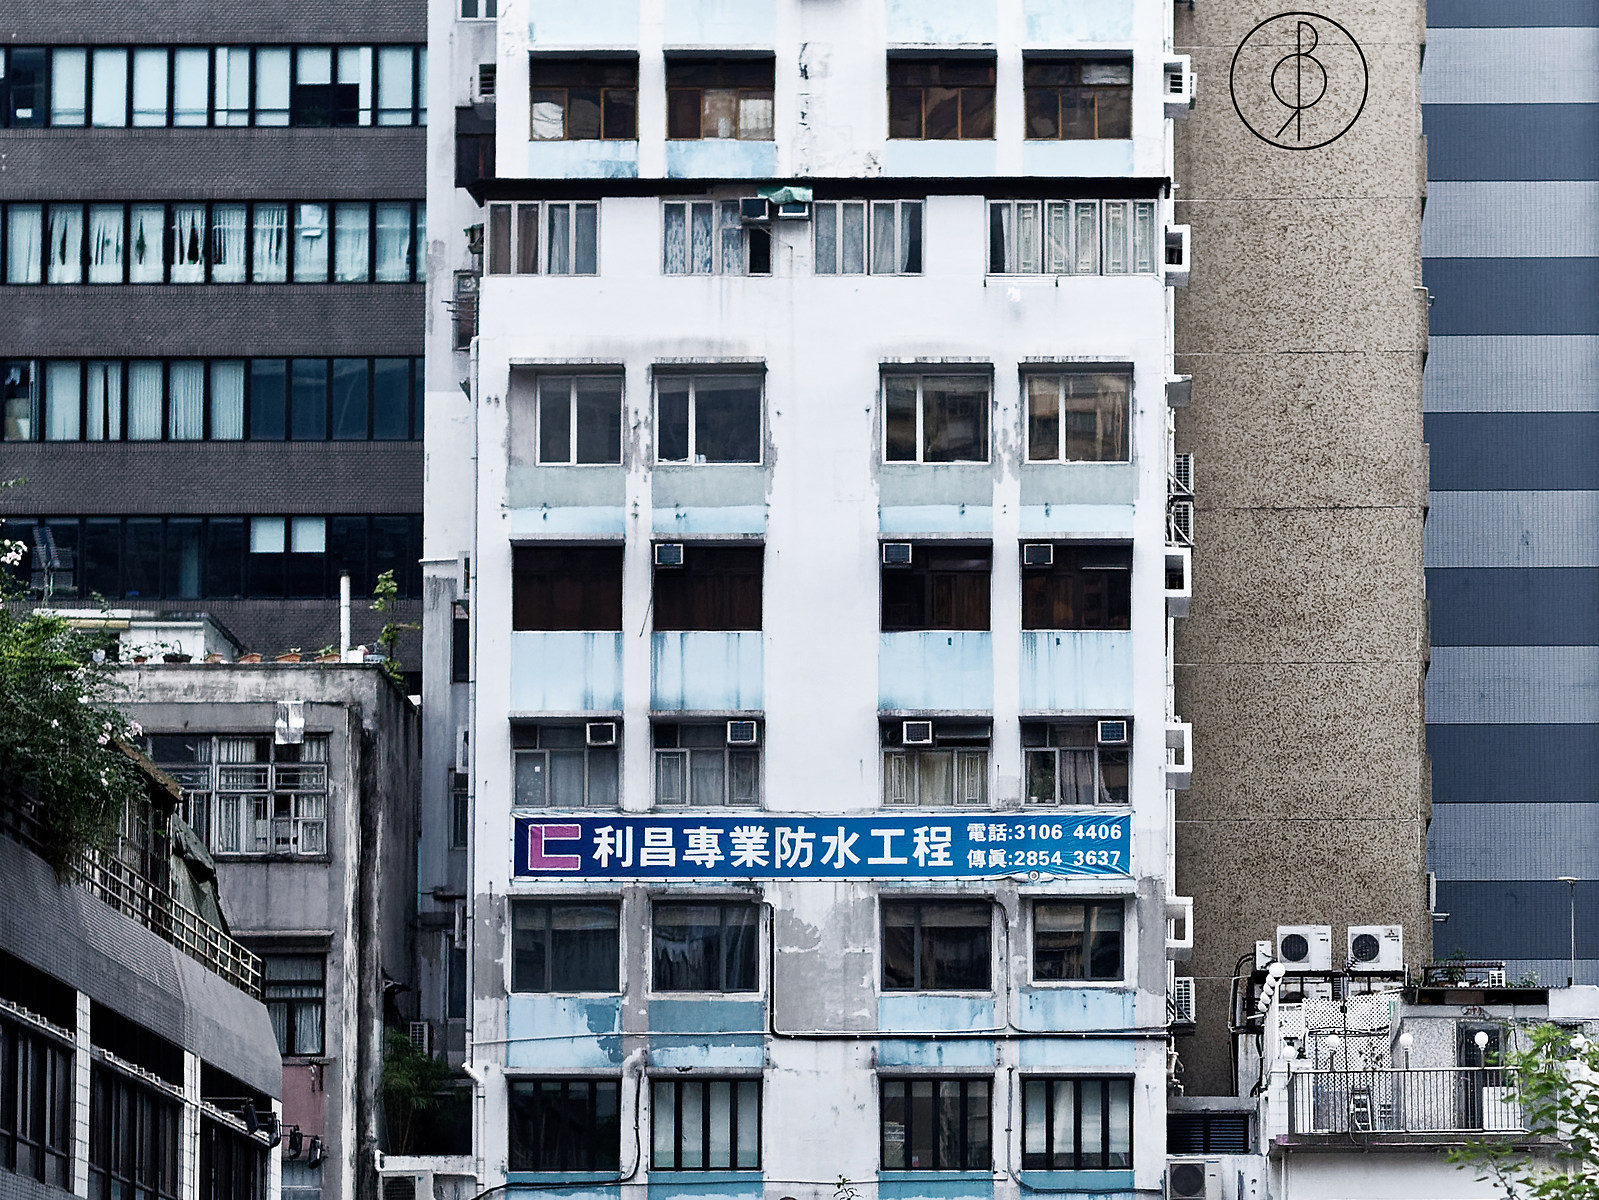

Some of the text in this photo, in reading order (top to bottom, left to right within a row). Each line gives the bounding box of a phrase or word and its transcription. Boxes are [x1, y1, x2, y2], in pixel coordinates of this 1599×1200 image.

[966, 823, 1122, 842] 電話:3106 4406
[592, 825, 954, 869] 利昌專業防水工程
[1073, 850, 1121, 866] 3637
